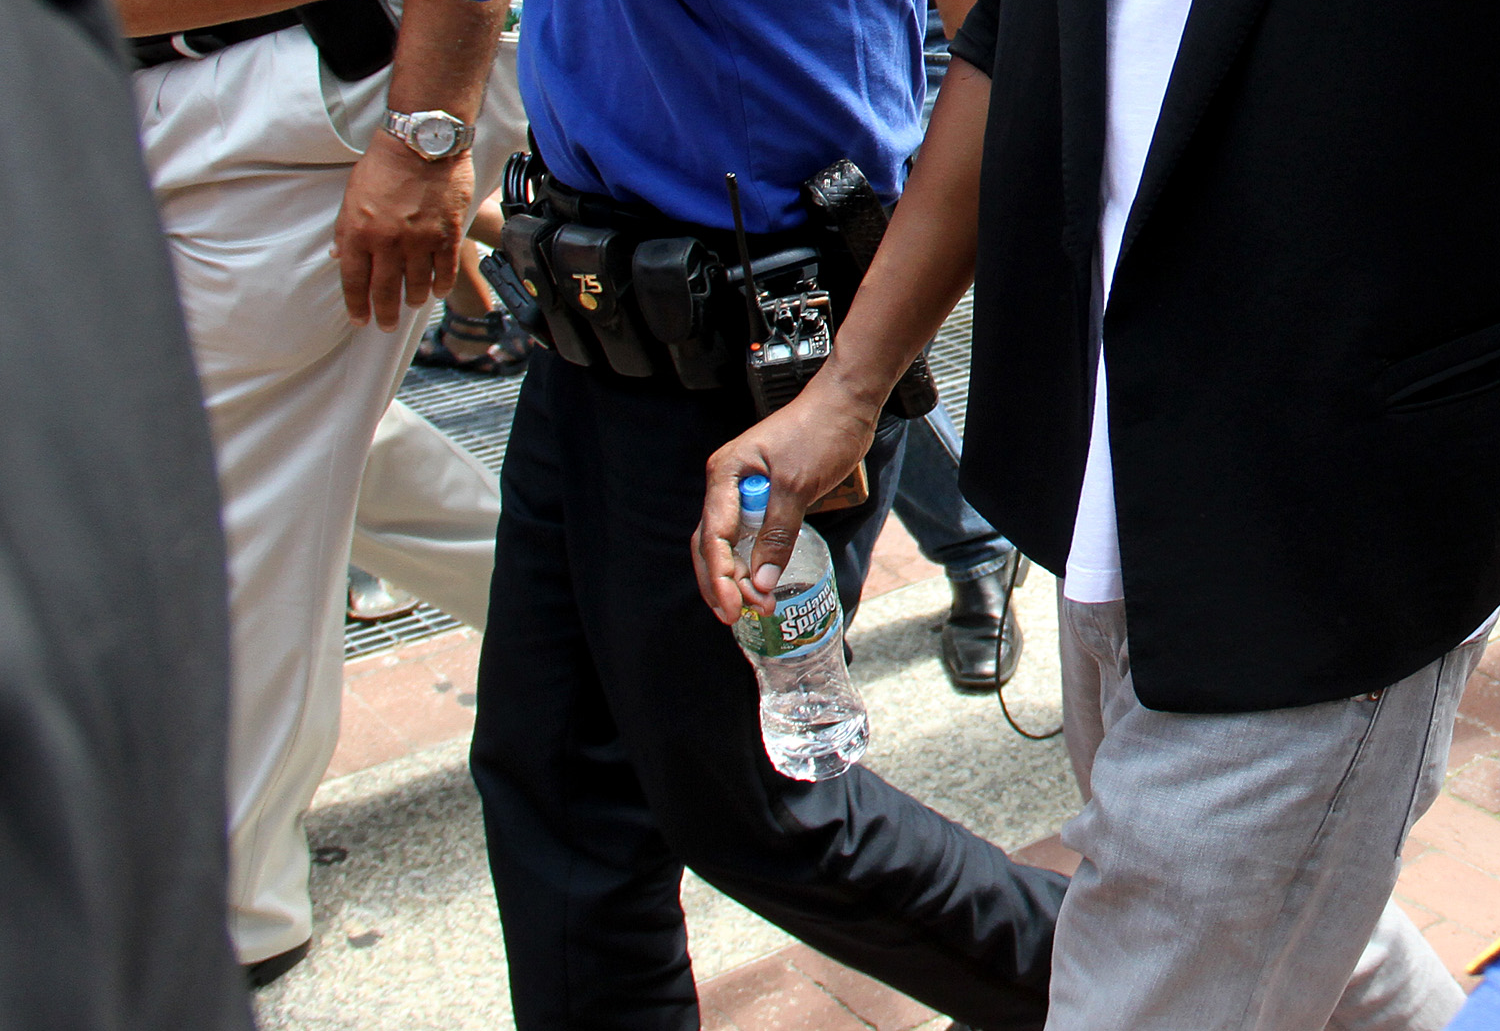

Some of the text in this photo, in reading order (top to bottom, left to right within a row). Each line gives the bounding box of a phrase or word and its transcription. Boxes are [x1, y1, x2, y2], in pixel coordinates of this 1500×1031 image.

[572, 273, 603, 294] 75
[780, 590, 837, 642] Spring
[784, 582, 831, 620] Poland
